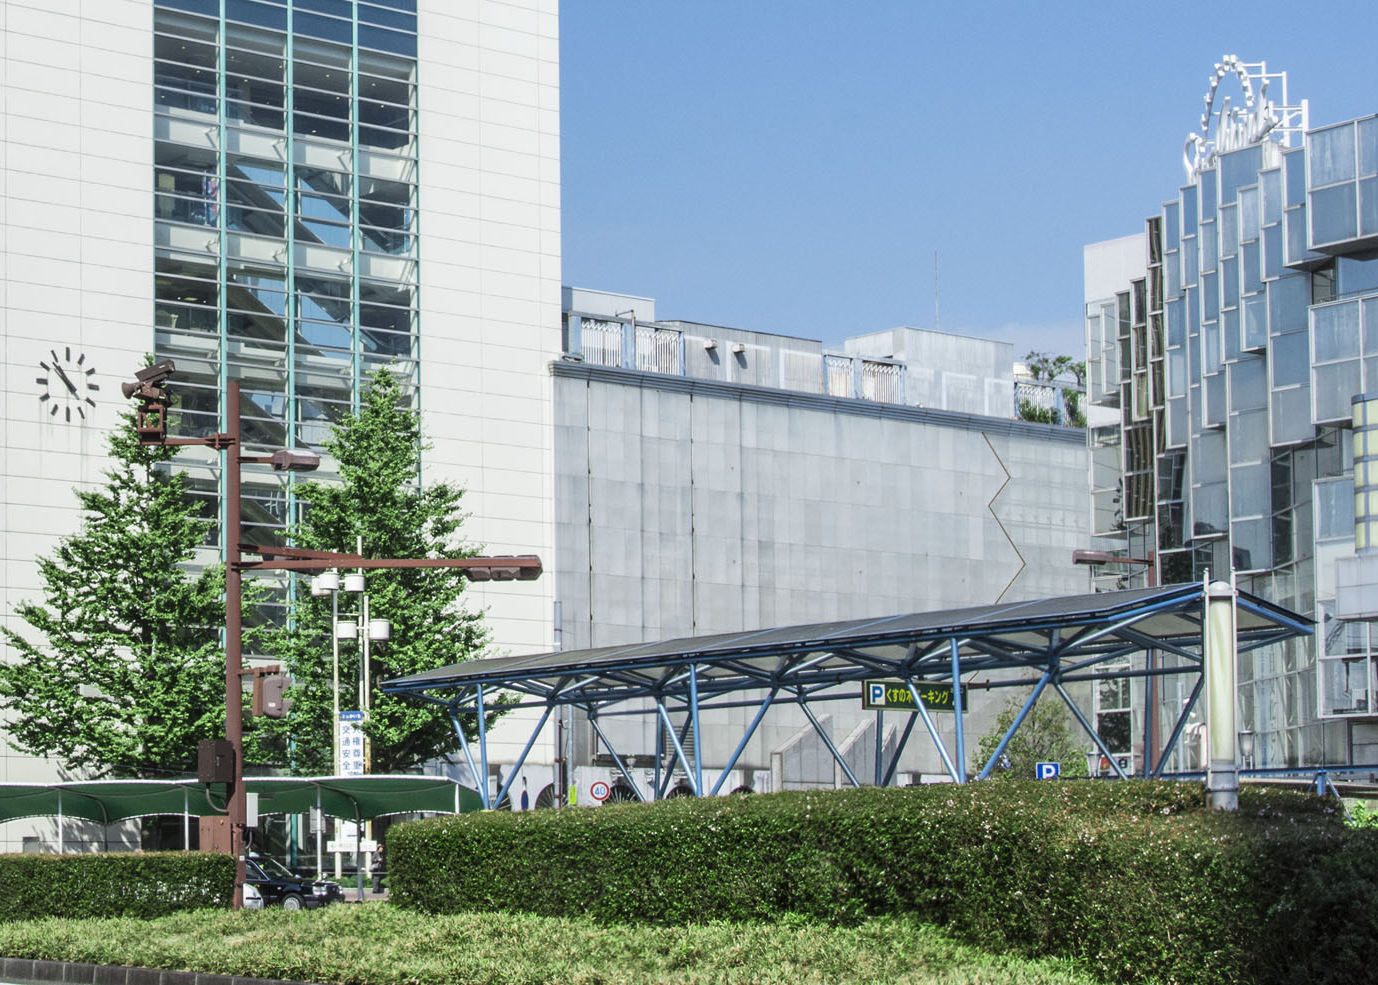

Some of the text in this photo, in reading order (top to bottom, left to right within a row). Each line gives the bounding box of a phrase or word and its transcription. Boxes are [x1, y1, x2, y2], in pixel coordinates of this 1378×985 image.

[872, 685, 949, 705] P くすの木ーキング
[594, 786, 606, 796] 40
